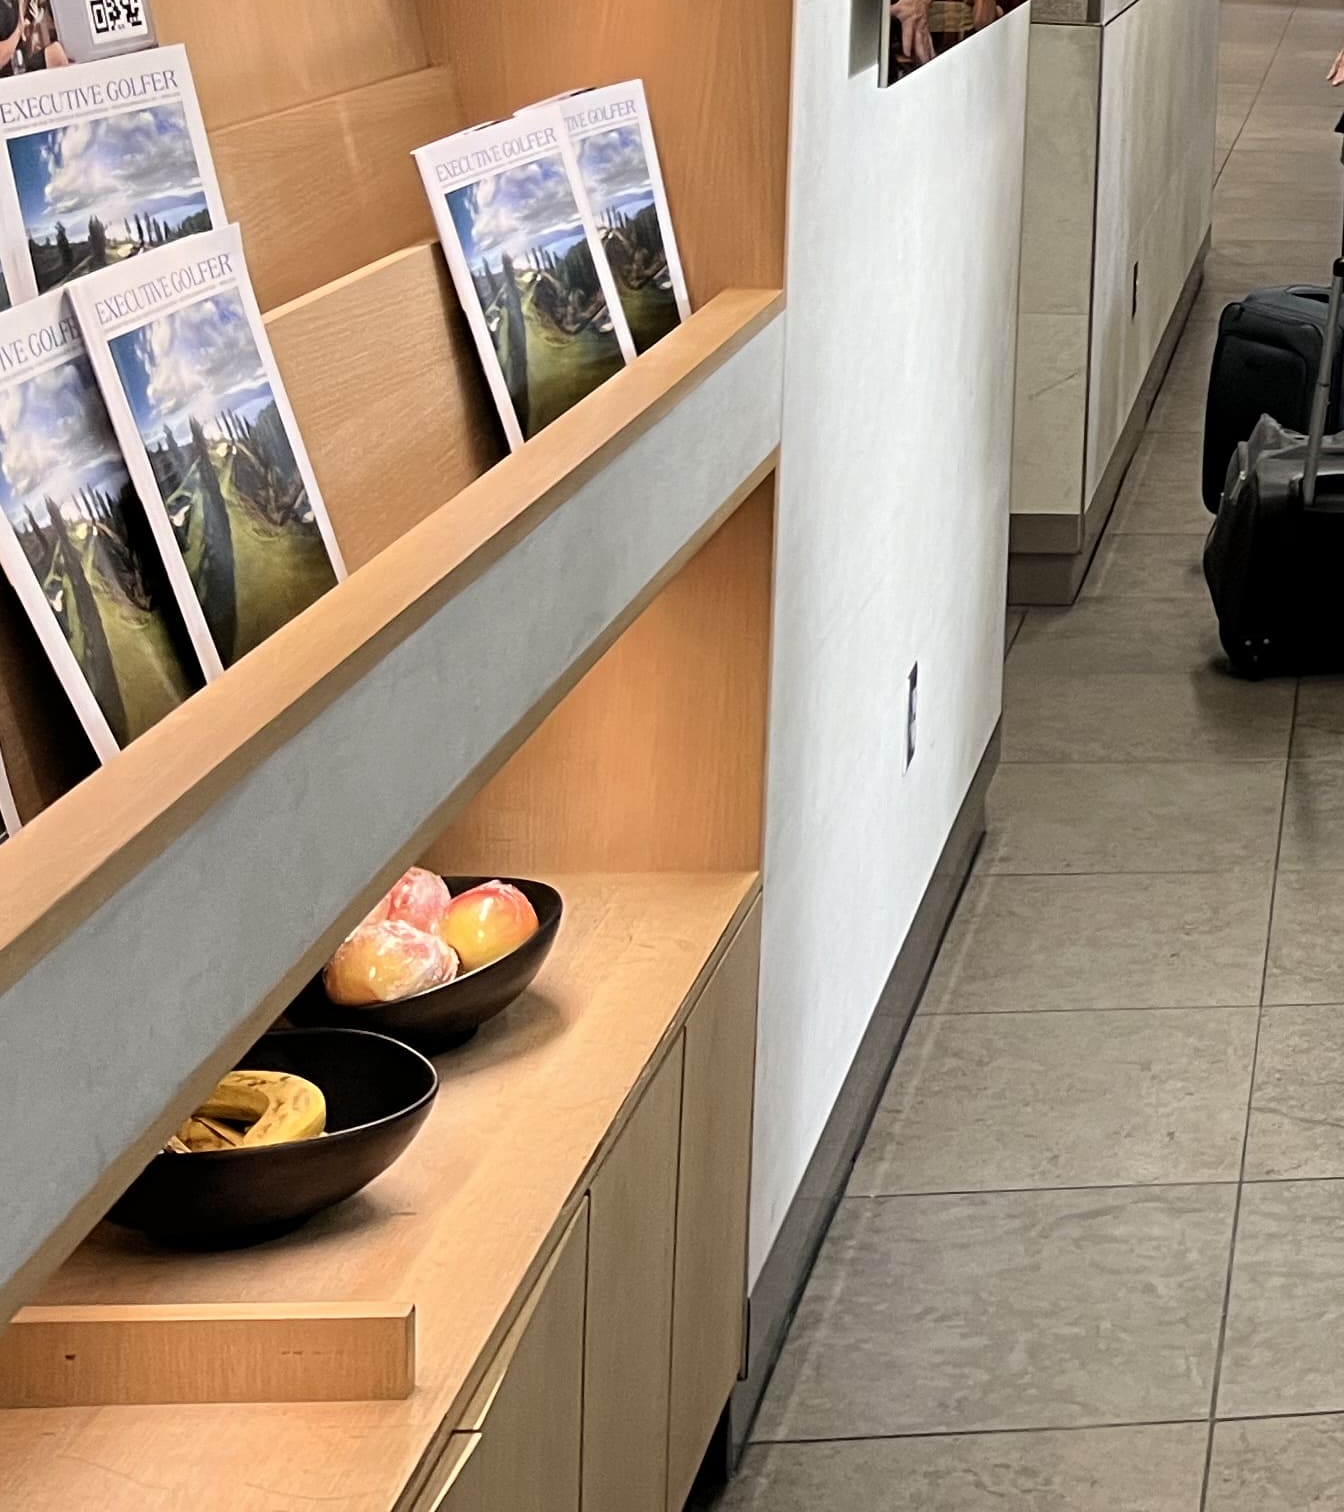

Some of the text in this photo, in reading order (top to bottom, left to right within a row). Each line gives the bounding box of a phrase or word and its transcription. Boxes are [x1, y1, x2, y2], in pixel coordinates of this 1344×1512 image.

[0, 85, 105, 124] EXECUTIVE
[106, 69, 178, 101] GOLFER
[587, 99, 637, 125] GOLFER
[434, 146, 501, 183] EXECUTIVE
[502, 127, 558, 159] GOLFER
[95, 275, 170, 325] EXECUTIVE
[170, 252, 233, 294] GOLFER
